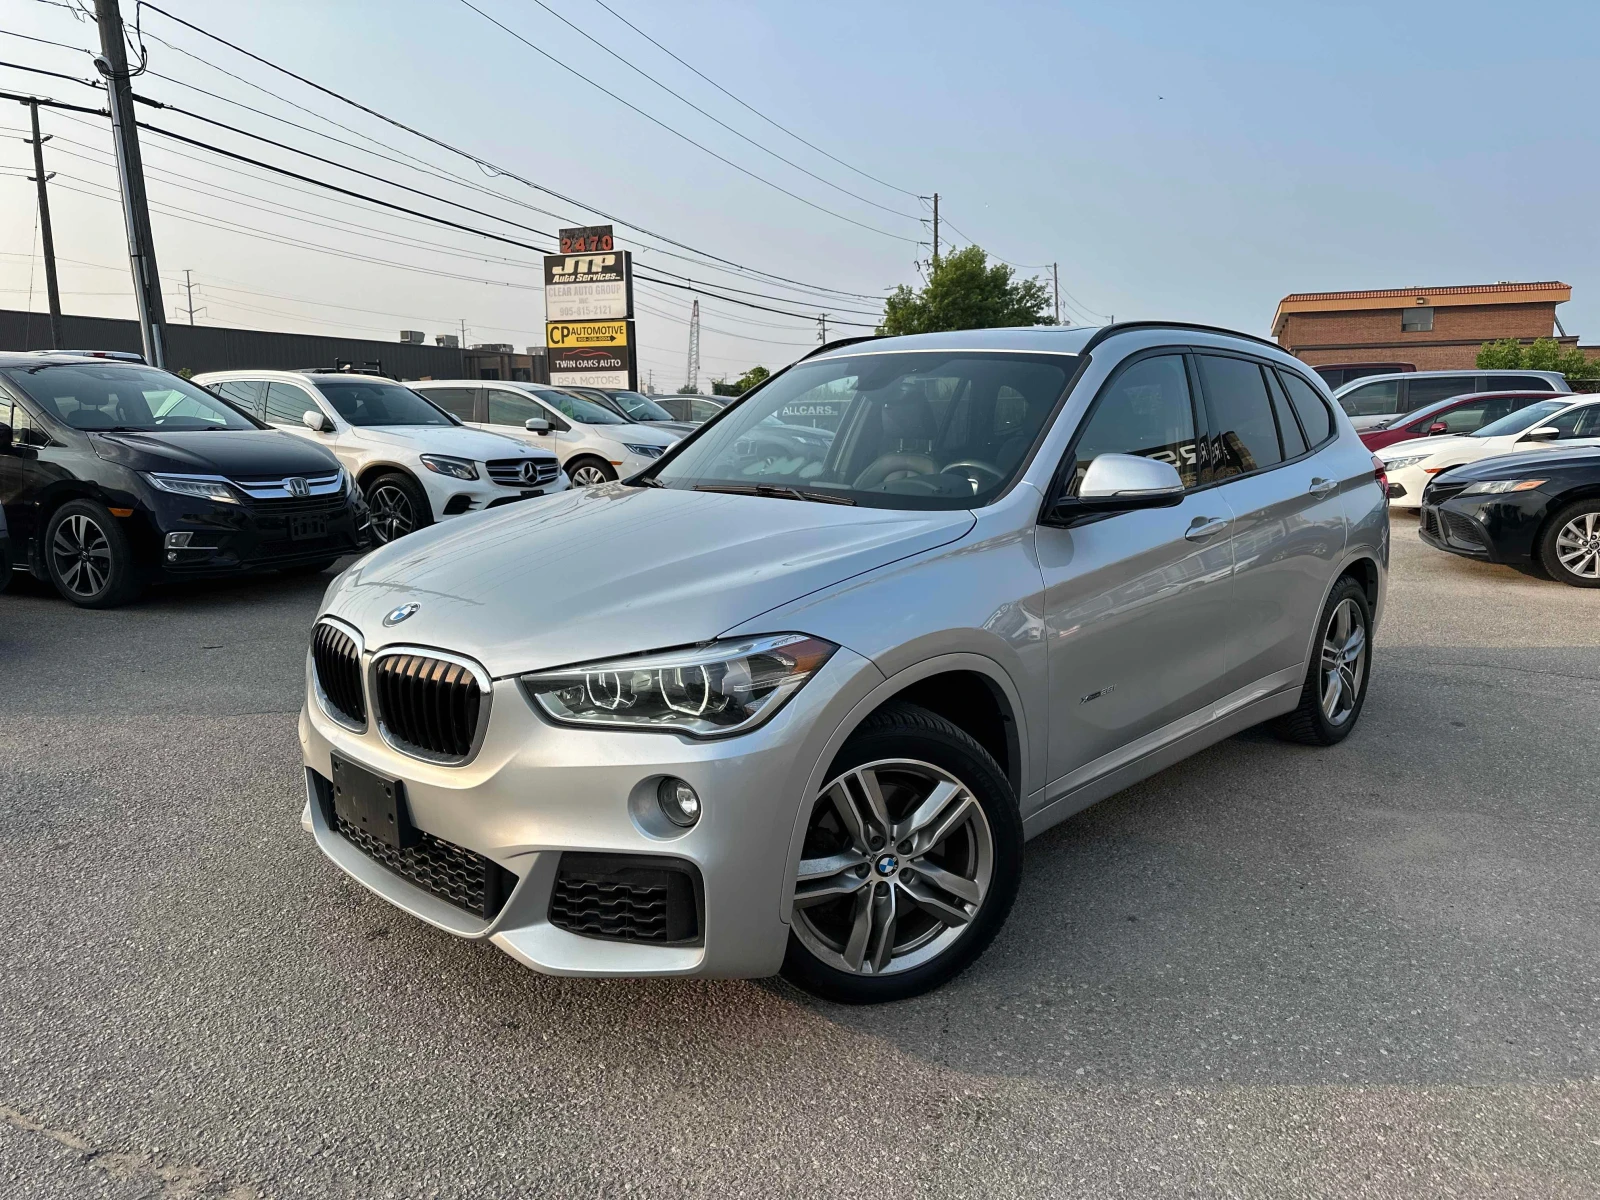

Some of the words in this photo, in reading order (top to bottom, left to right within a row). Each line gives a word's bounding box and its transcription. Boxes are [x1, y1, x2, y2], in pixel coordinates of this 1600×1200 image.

[562, 235, 612, 254] 2470
[552, 255, 615, 274] JTP
[576, 273, 616, 281] Services
[549, 287, 572, 297] CLEAR
[574, 286, 593, 296] AUTO
[595, 284, 620, 294] GROUP
[560, 305, 611, 316] 905-815-2121
[550, 326, 570, 344] CP
[571, 326, 623, 335] AUTOMOTIVE
[555, 360, 576, 368] TWIN
[576, 360, 599, 368] OAKS
[599, 358, 622, 367] AUTO
[558, 376, 576, 385] RSA
[580, 376, 620, 385] MOTORS
